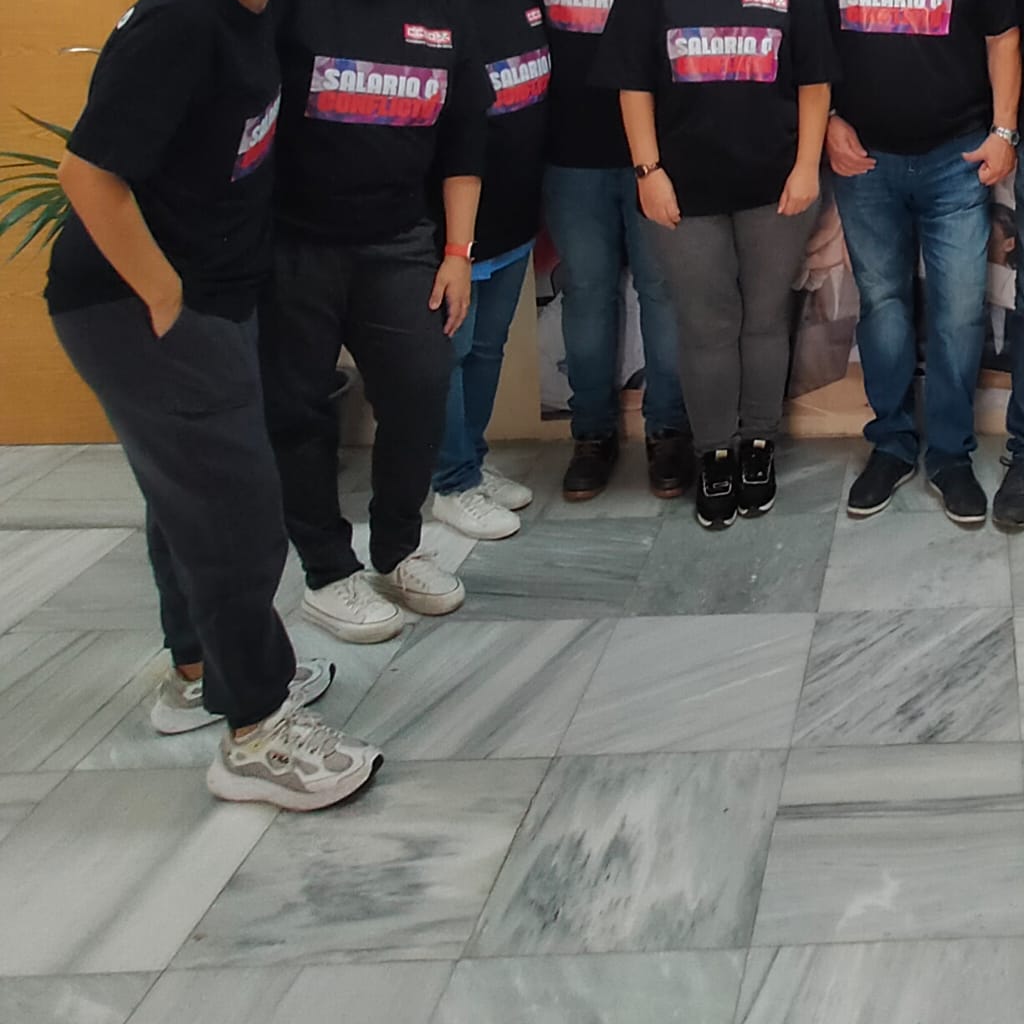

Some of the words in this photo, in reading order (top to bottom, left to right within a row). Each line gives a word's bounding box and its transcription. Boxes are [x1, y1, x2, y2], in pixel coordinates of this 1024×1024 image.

[675, 37, 757, 56] SALARIO
[322, 68, 421, 99] SALARIO
[489, 55, 548, 91] SALARIO
